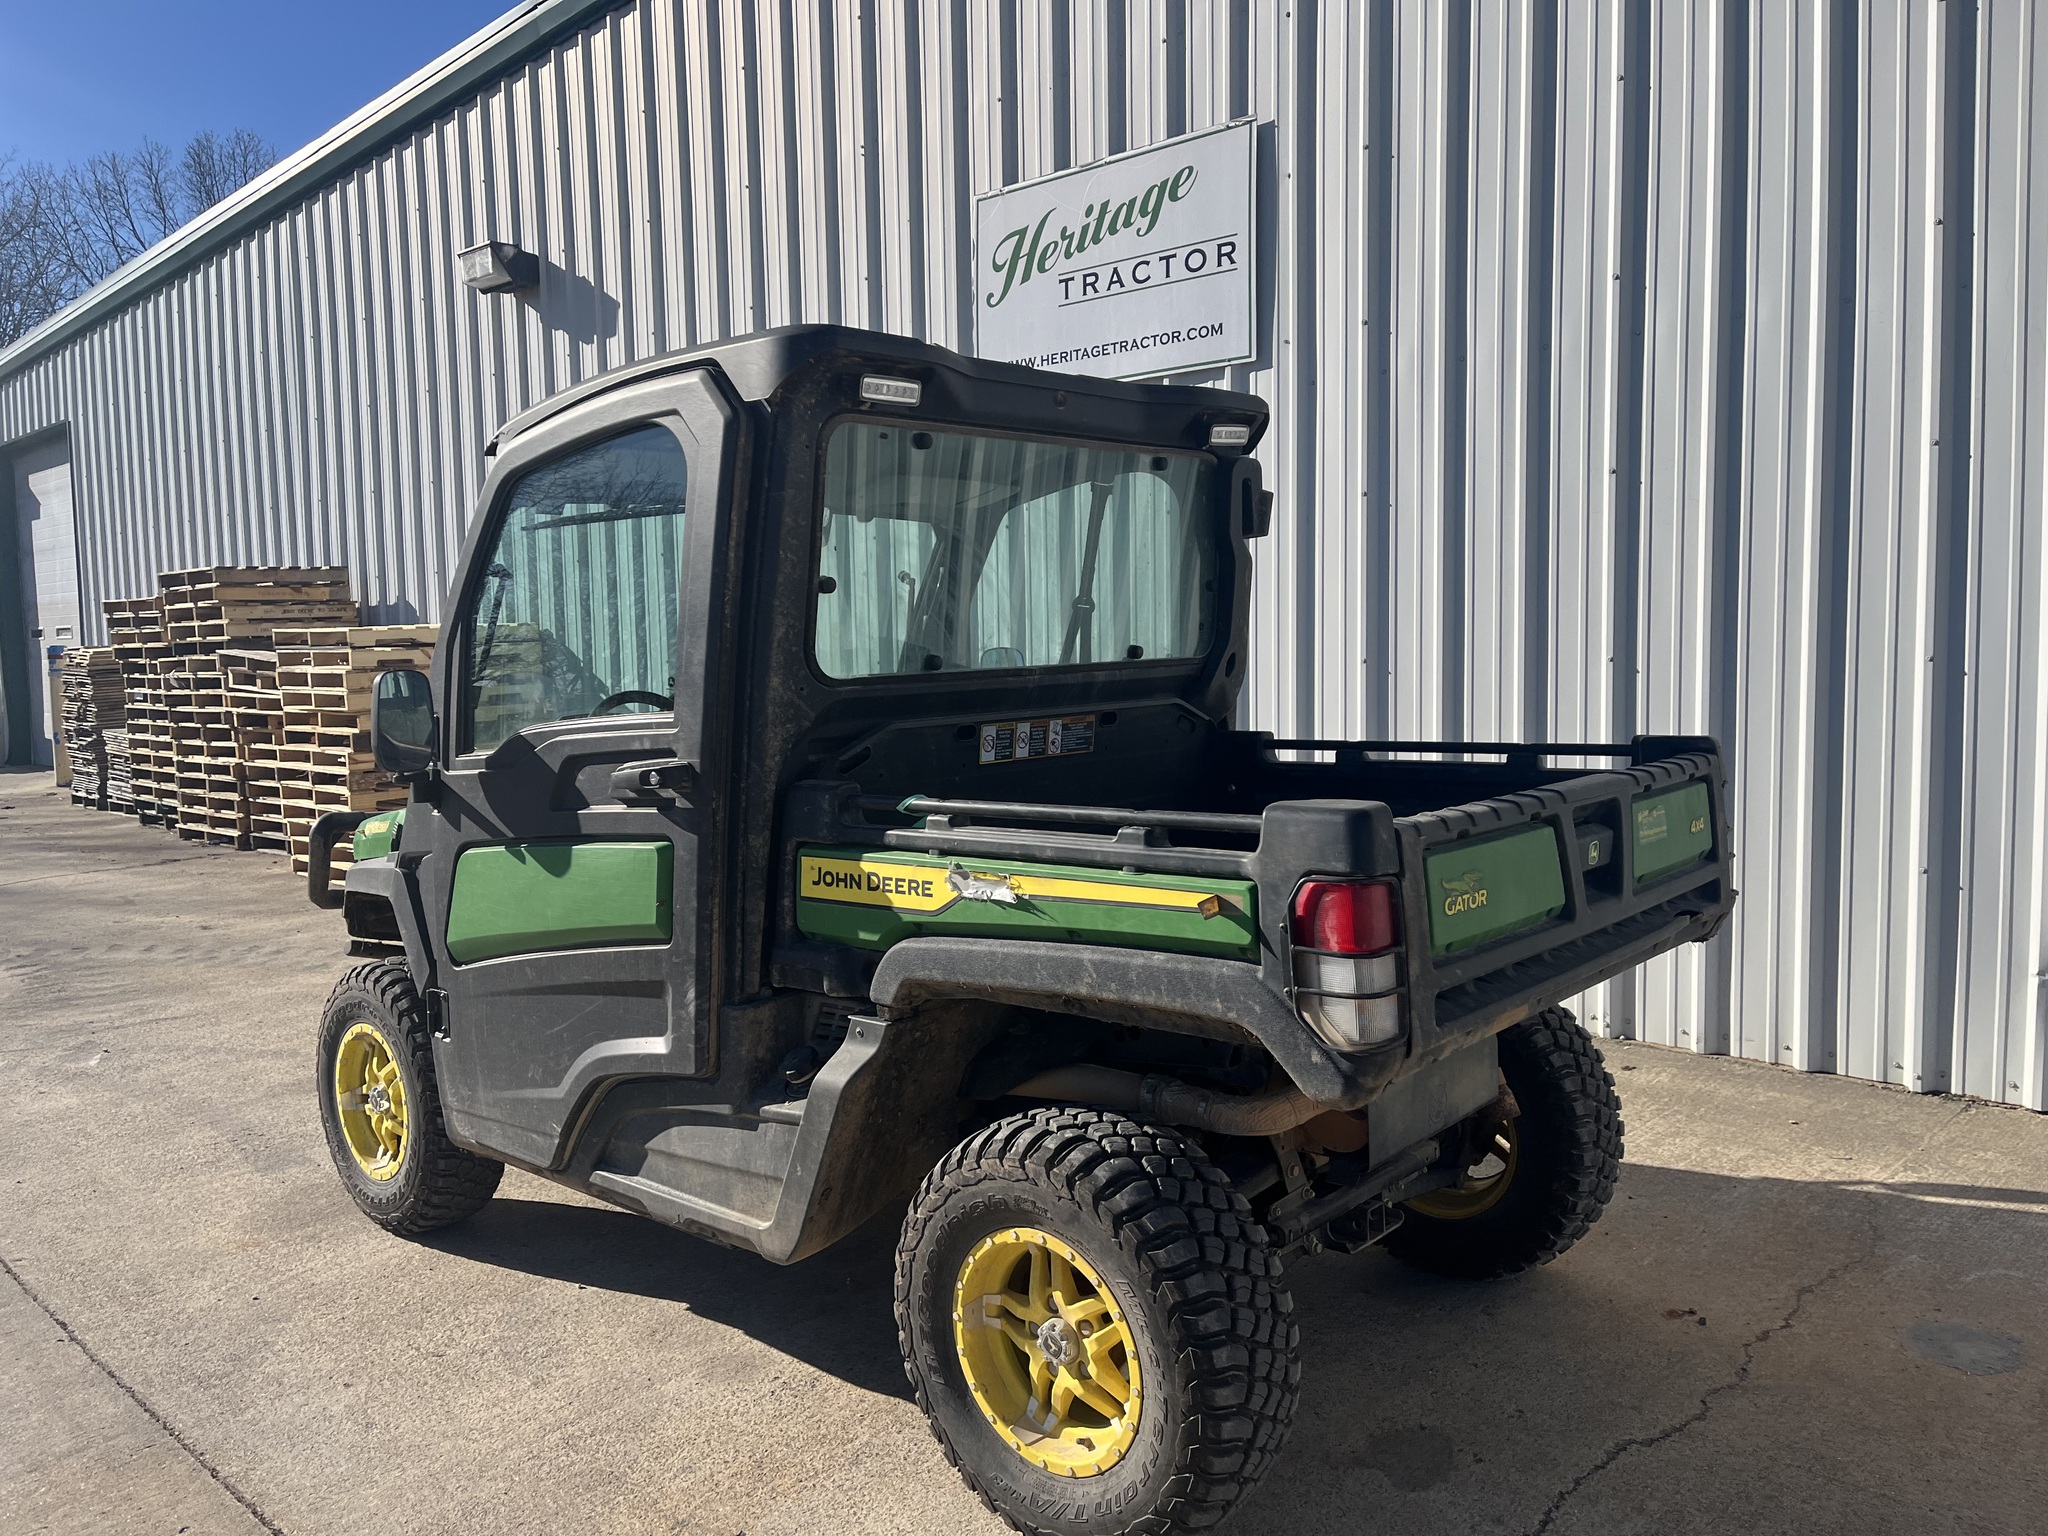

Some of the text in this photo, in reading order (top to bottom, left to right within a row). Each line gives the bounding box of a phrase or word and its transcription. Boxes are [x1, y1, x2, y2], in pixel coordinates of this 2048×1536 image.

[987, 165, 1199, 308] Heritage
[1058, 240, 1238, 300] TRACTOR
[1008, 322, 1224, 368] WW.HERITAGETRACTOR.COM
[812, 867, 934, 898] JOHN DEERE
[1444, 889, 1488, 917] GATOR
